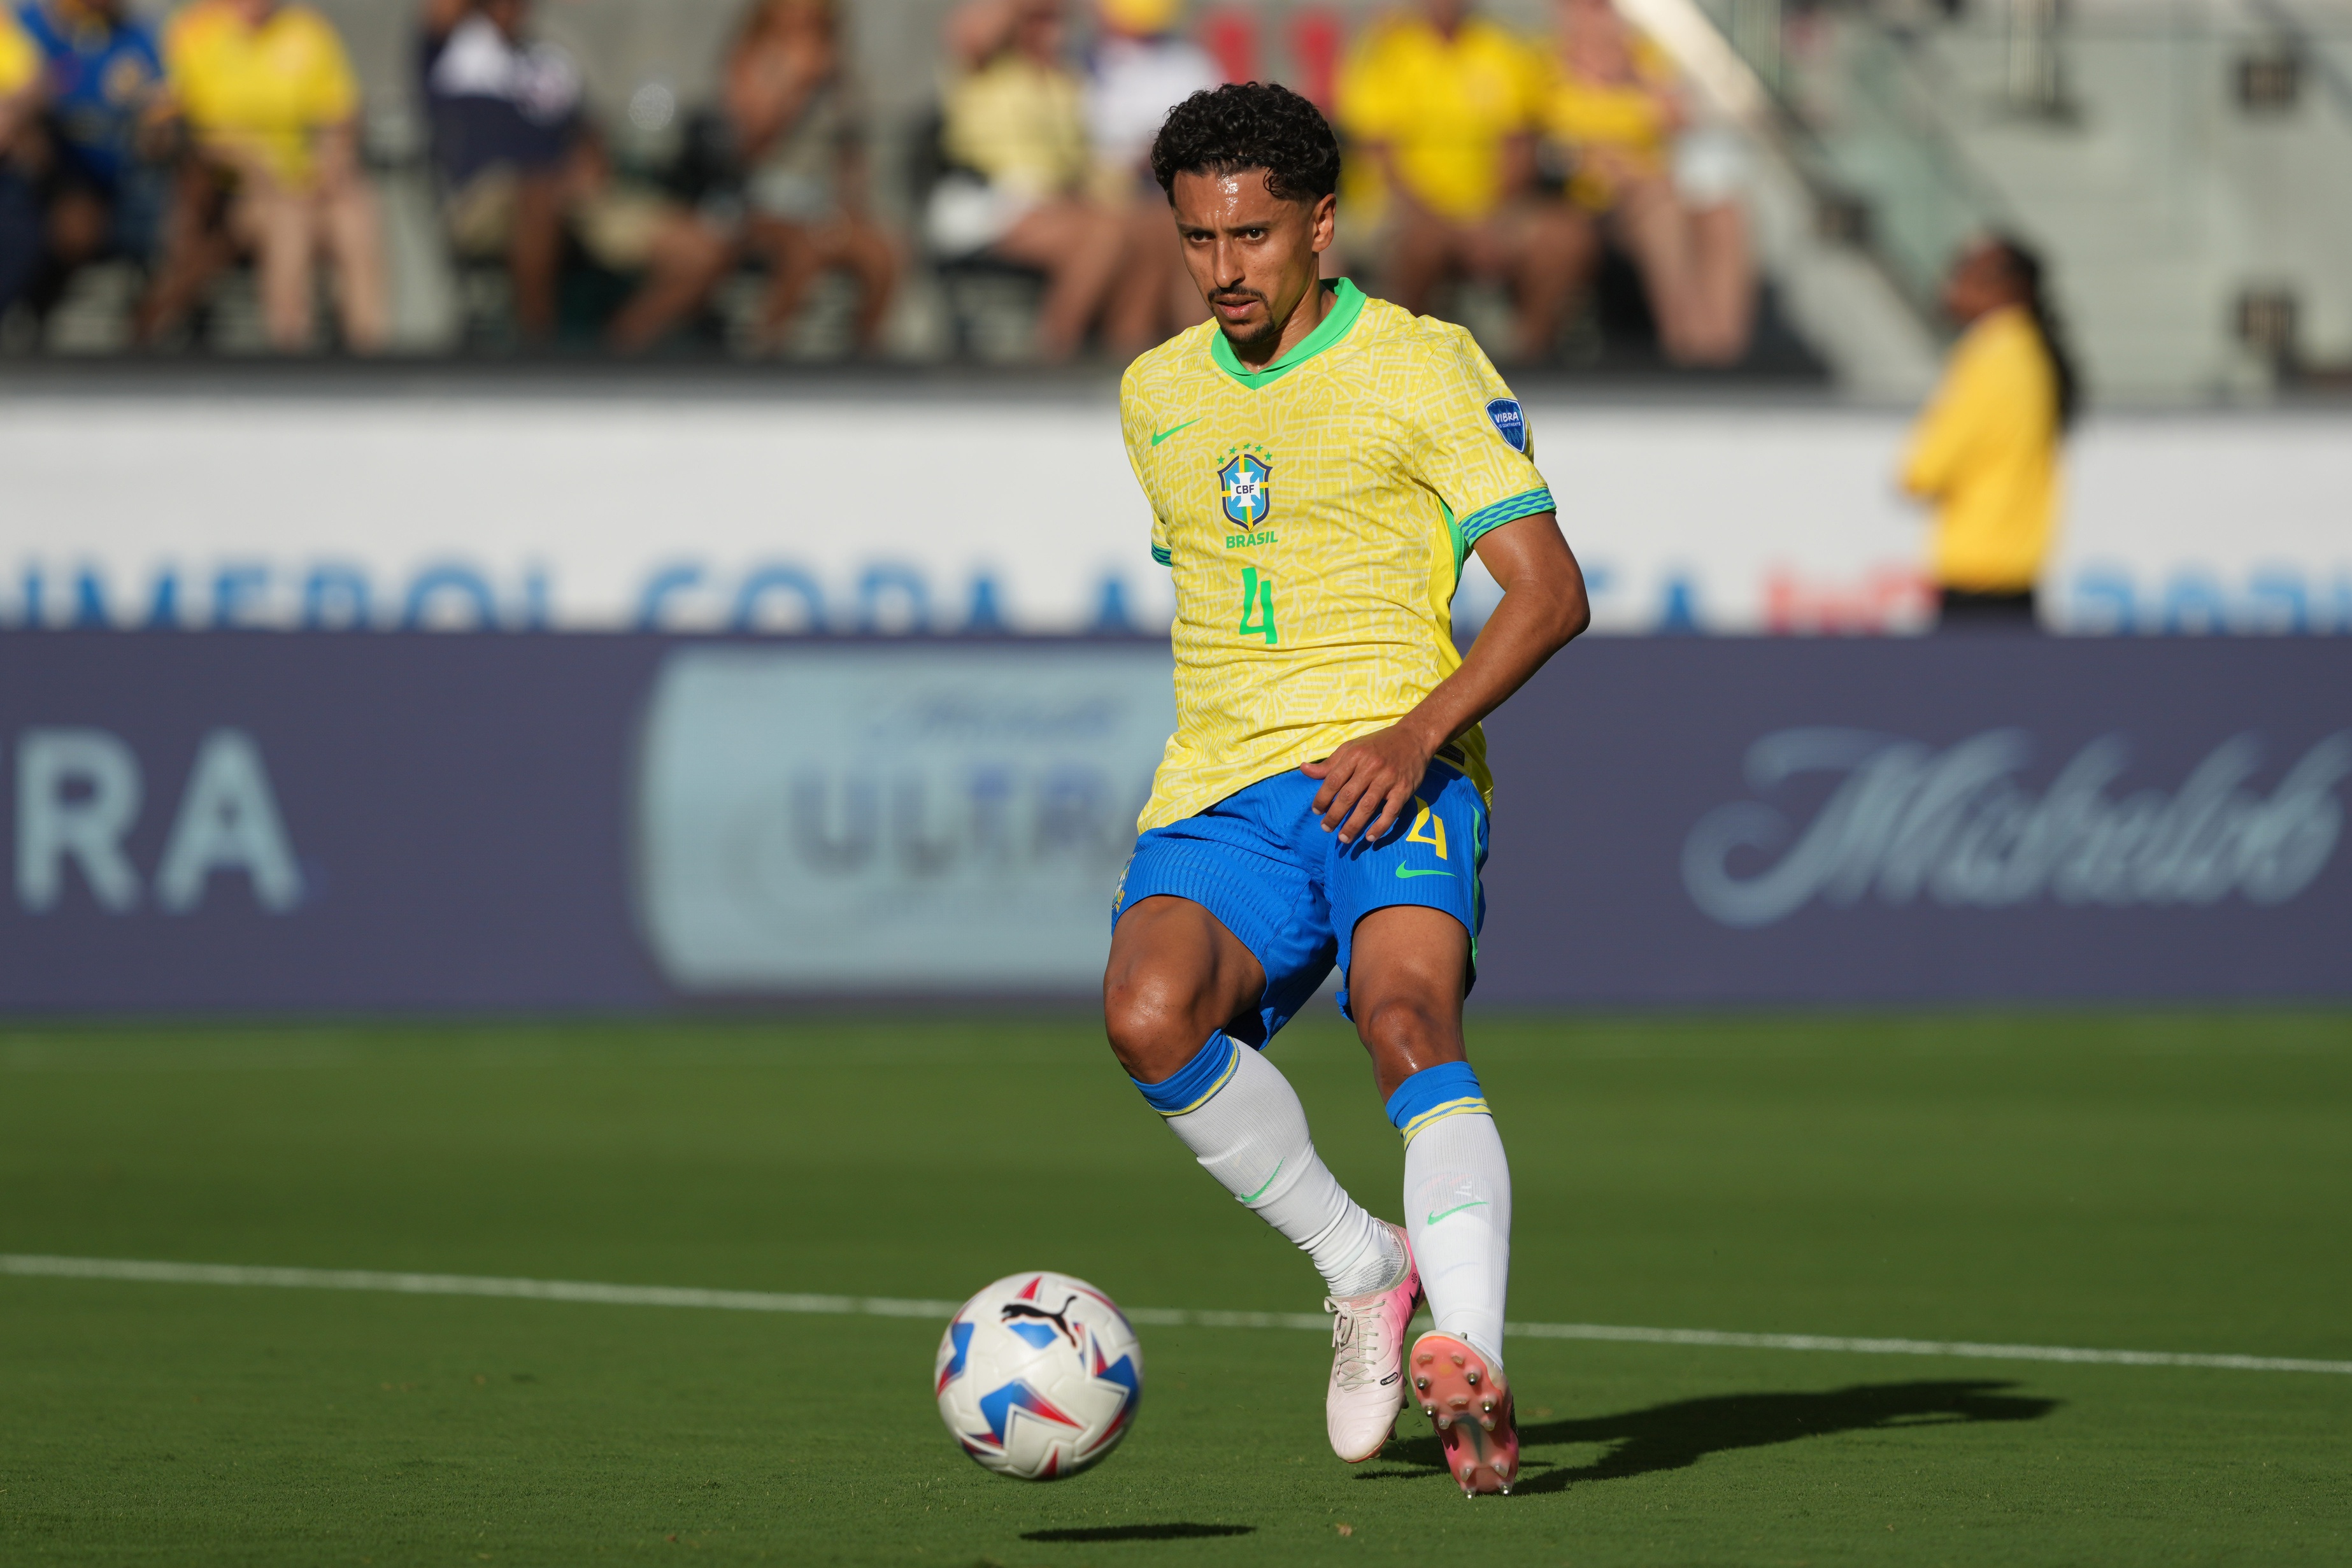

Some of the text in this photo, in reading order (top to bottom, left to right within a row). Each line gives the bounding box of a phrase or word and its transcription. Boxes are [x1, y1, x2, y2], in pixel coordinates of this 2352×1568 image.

[1495, 411, 1519, 423] VIBRA
[1236, 484, 1255, 495] CBF
[1226, 531, 1278, 549] BRASIL
[1239, 567, 1278, 645] 4
[1406, 794, 1448, 860] 4
